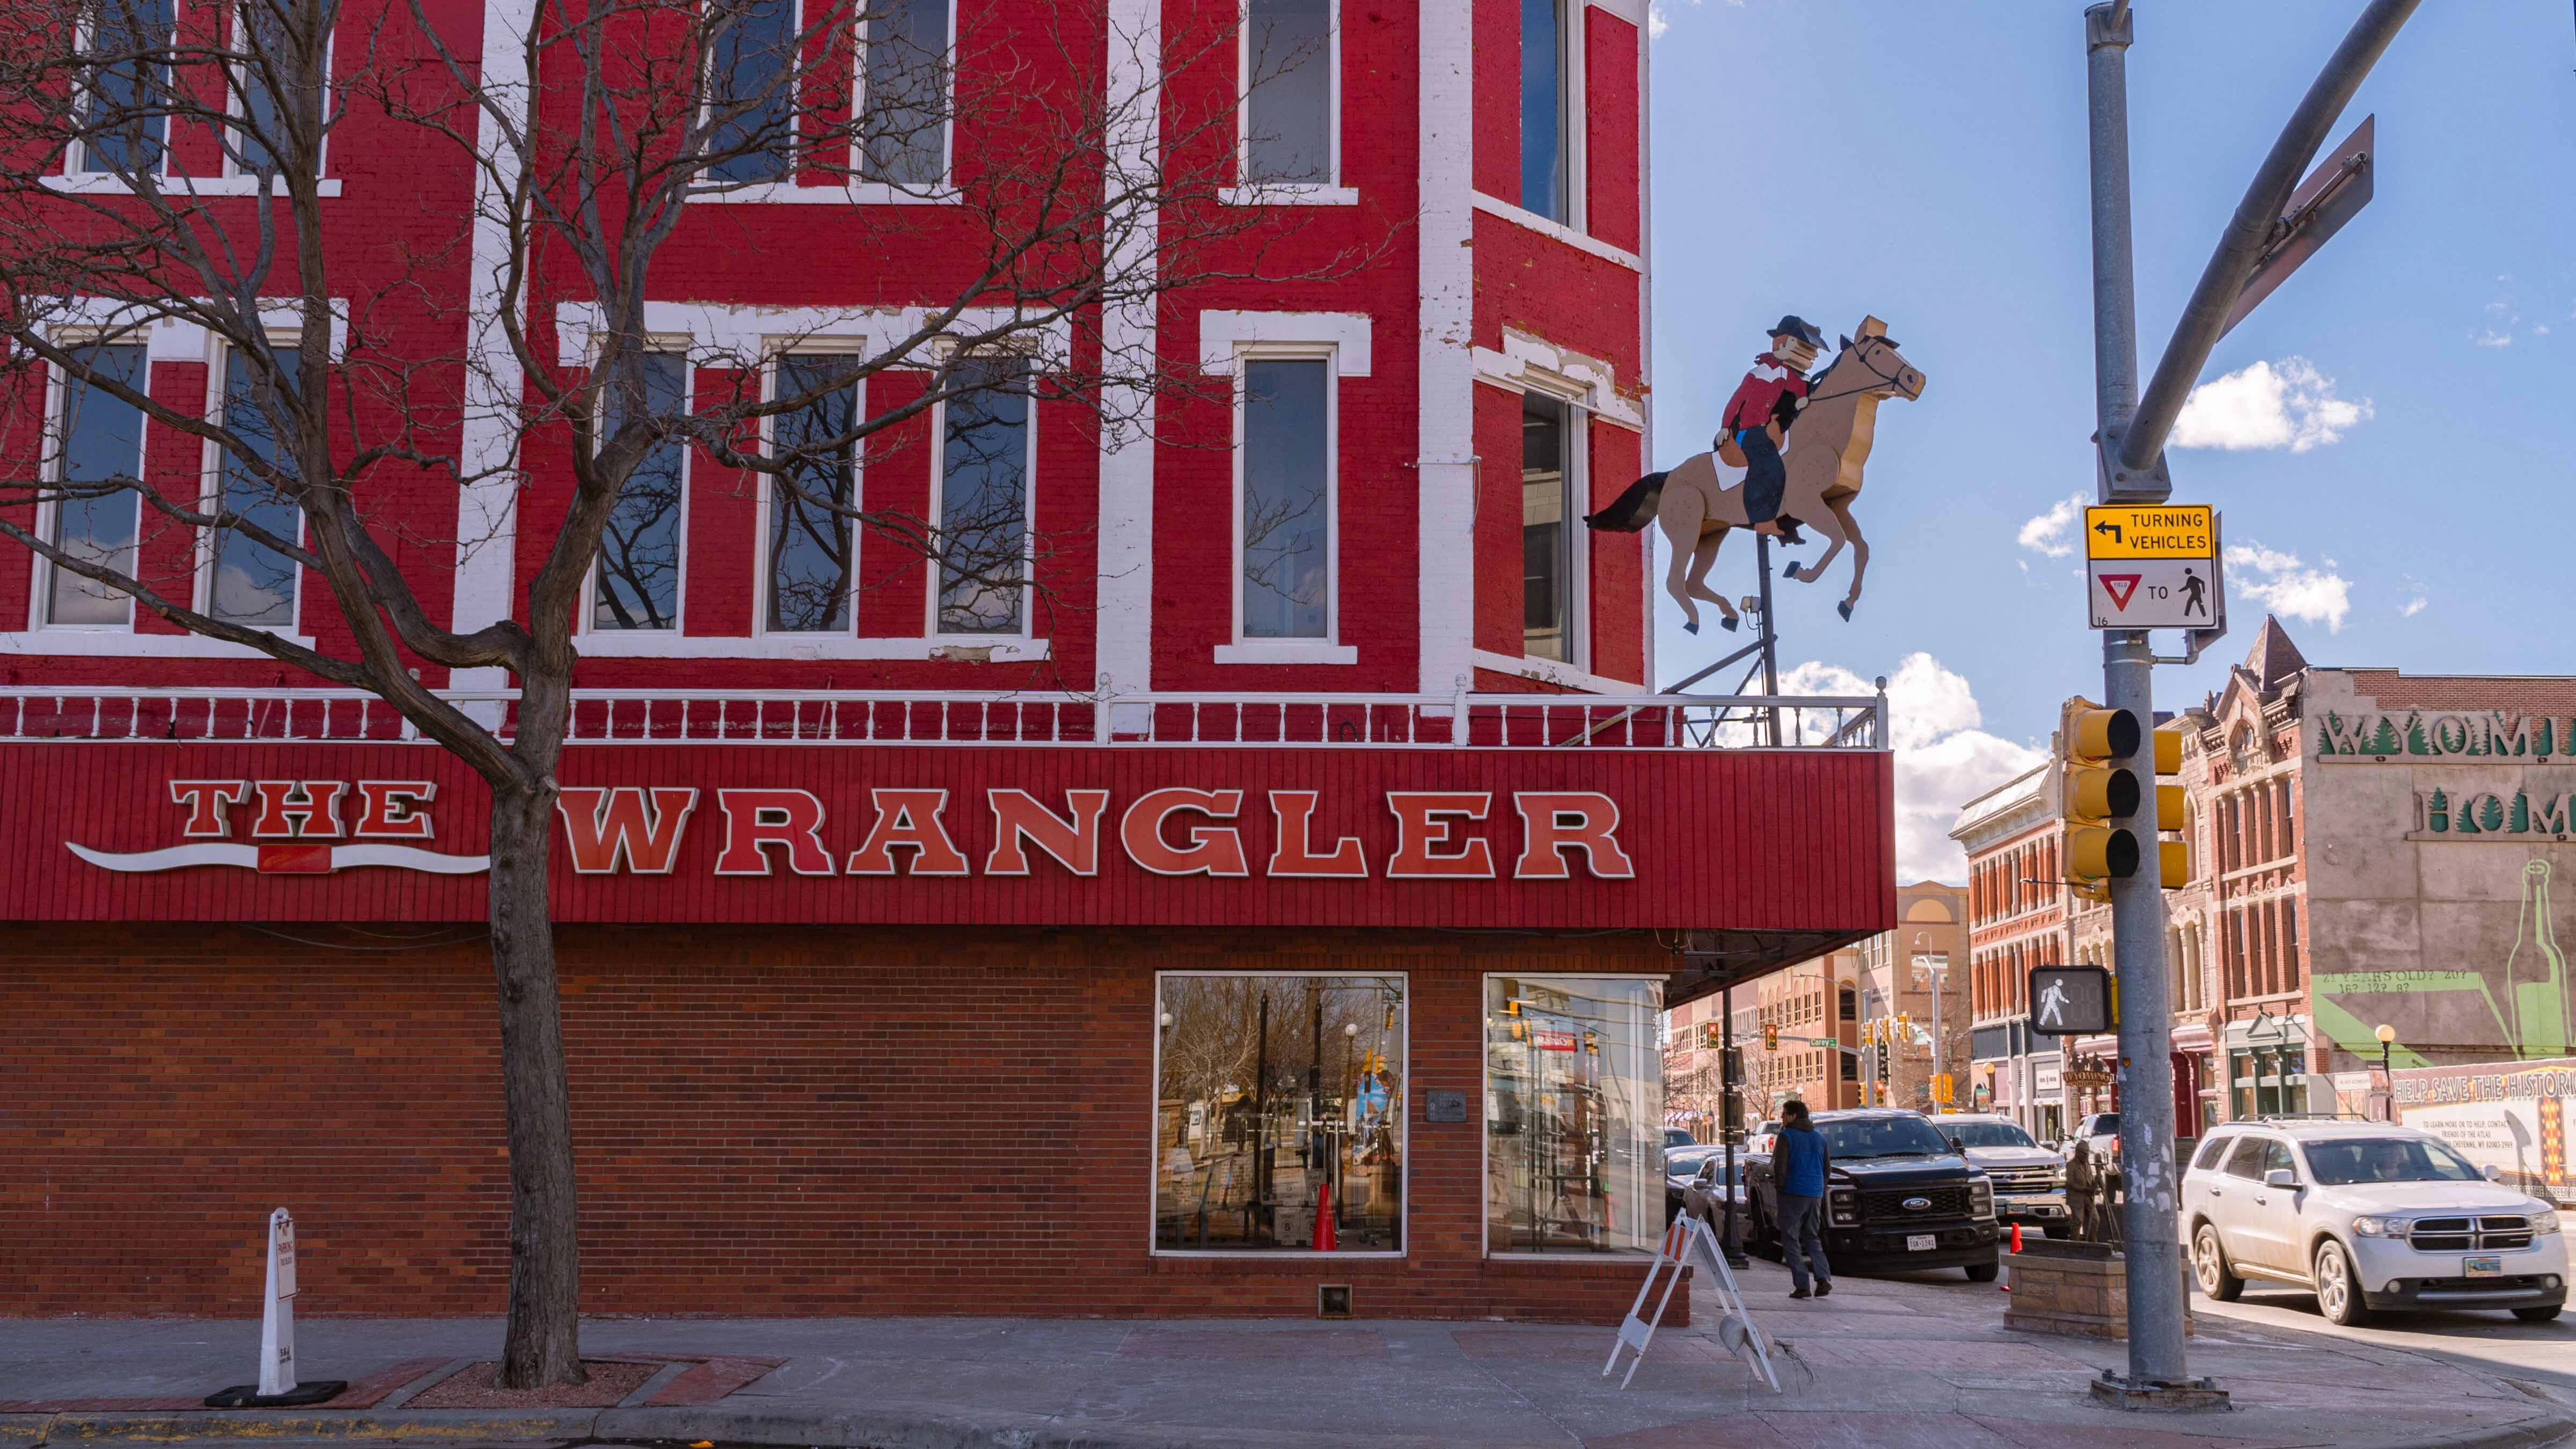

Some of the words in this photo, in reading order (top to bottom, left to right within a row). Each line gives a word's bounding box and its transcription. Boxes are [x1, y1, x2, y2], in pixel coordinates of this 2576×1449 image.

[2130, 514, 2203, 528] TURNING
[2129, 536, 2206, 549] VEHICLES
[2148, 586, 2168, 599] TO
[2097, 617, 2109, 626] 16
[169, 779, 437, 839] THE
[556, 786, 1636, 879] WRANGLER
[2341, 970, 2392, 983] YEARS
[2396, 970, 2434, 982] OLD?
[2339, 983, 2358, 994] 16?
[2367, 983, 2387, 993] 12?
[2396, 983, 2410, 993] 8?
[2065, 1071, 2110, 1082] WYOMING
[2394, 1078, 2428, 1103] HELP
[2433, 1075, 2469, 1101] SAVE
[2473, 1073, 2502, 1100] THE
[2507, 1070, 2576, 1099] HISTORI
[2531, 1185, 2544, 1197] THE
[2545, 1185, 2569, 1198] STREET
